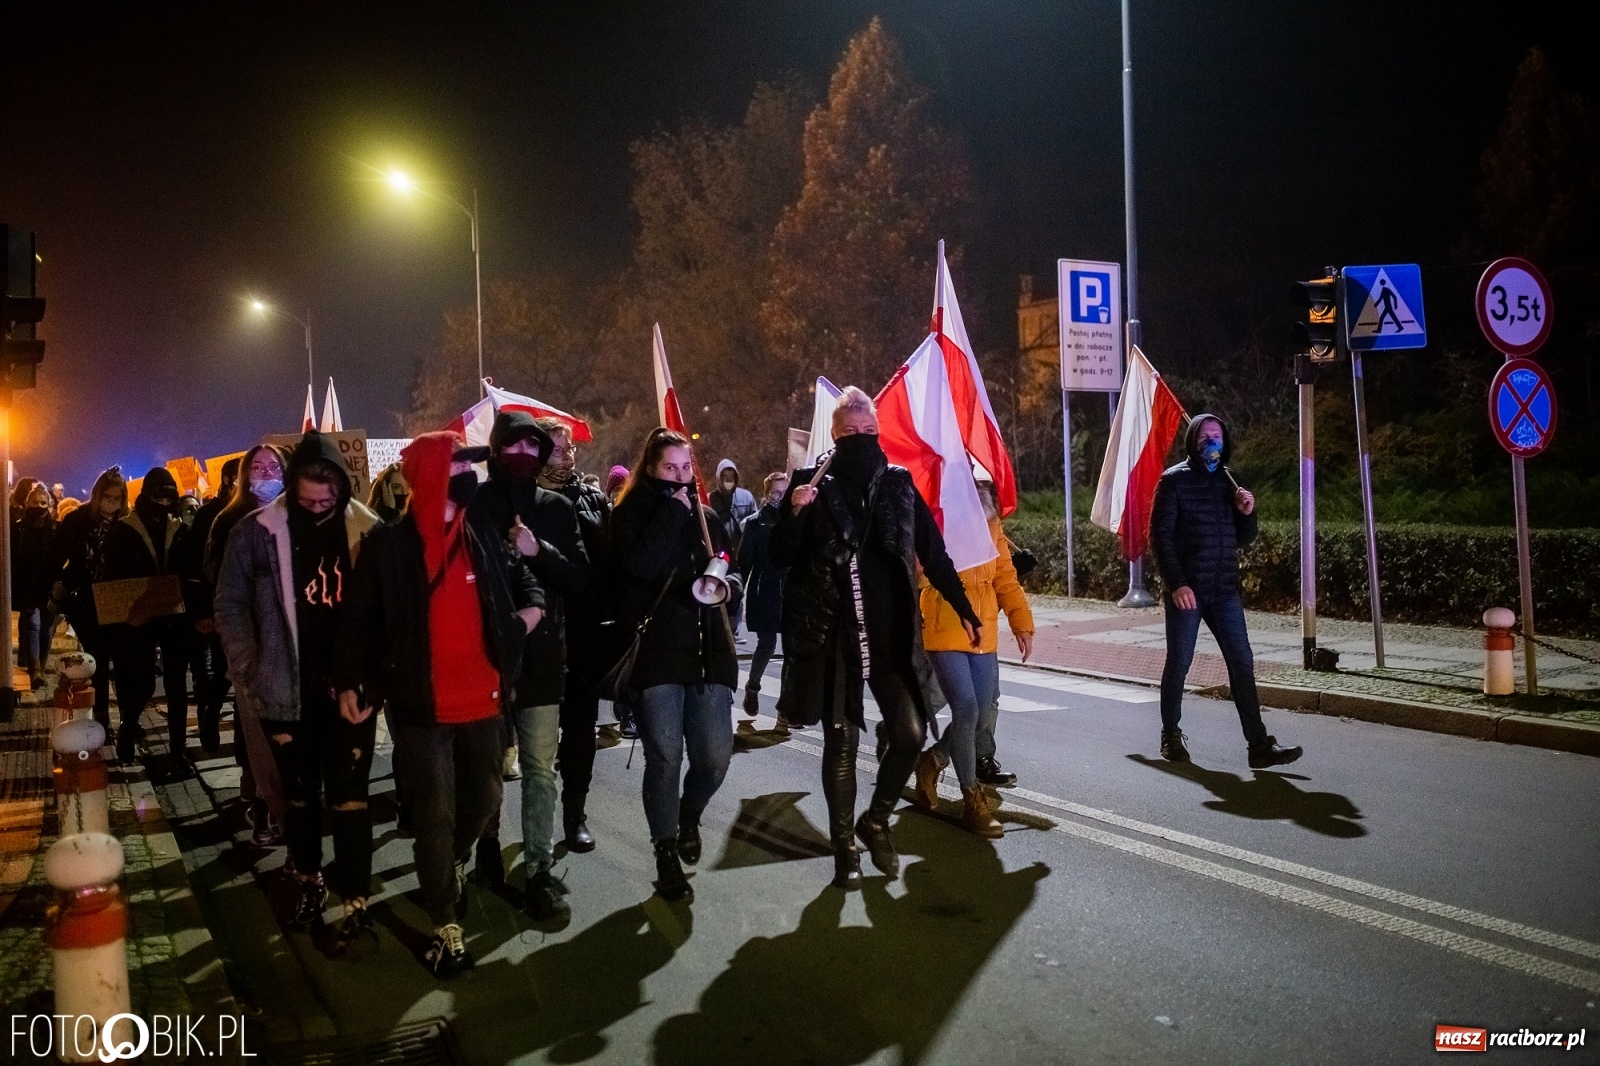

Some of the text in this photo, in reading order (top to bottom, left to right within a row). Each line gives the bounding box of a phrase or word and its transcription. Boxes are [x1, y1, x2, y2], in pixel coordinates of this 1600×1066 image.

[1079, 276, 1103, 317] P
[1490, 285, 1541, 326] 3,5t
[1069, 328, 1089, 339] Postoj
[1074, 342, 1085, 350] dni
[1087, 343, 1113, 351] robocze
[851, 573, 861, 591] LIFE
[853, 591, 862, 600] IS
[860, 641, 870, 660] LIFE
[862, 659, 870, 667] IS
